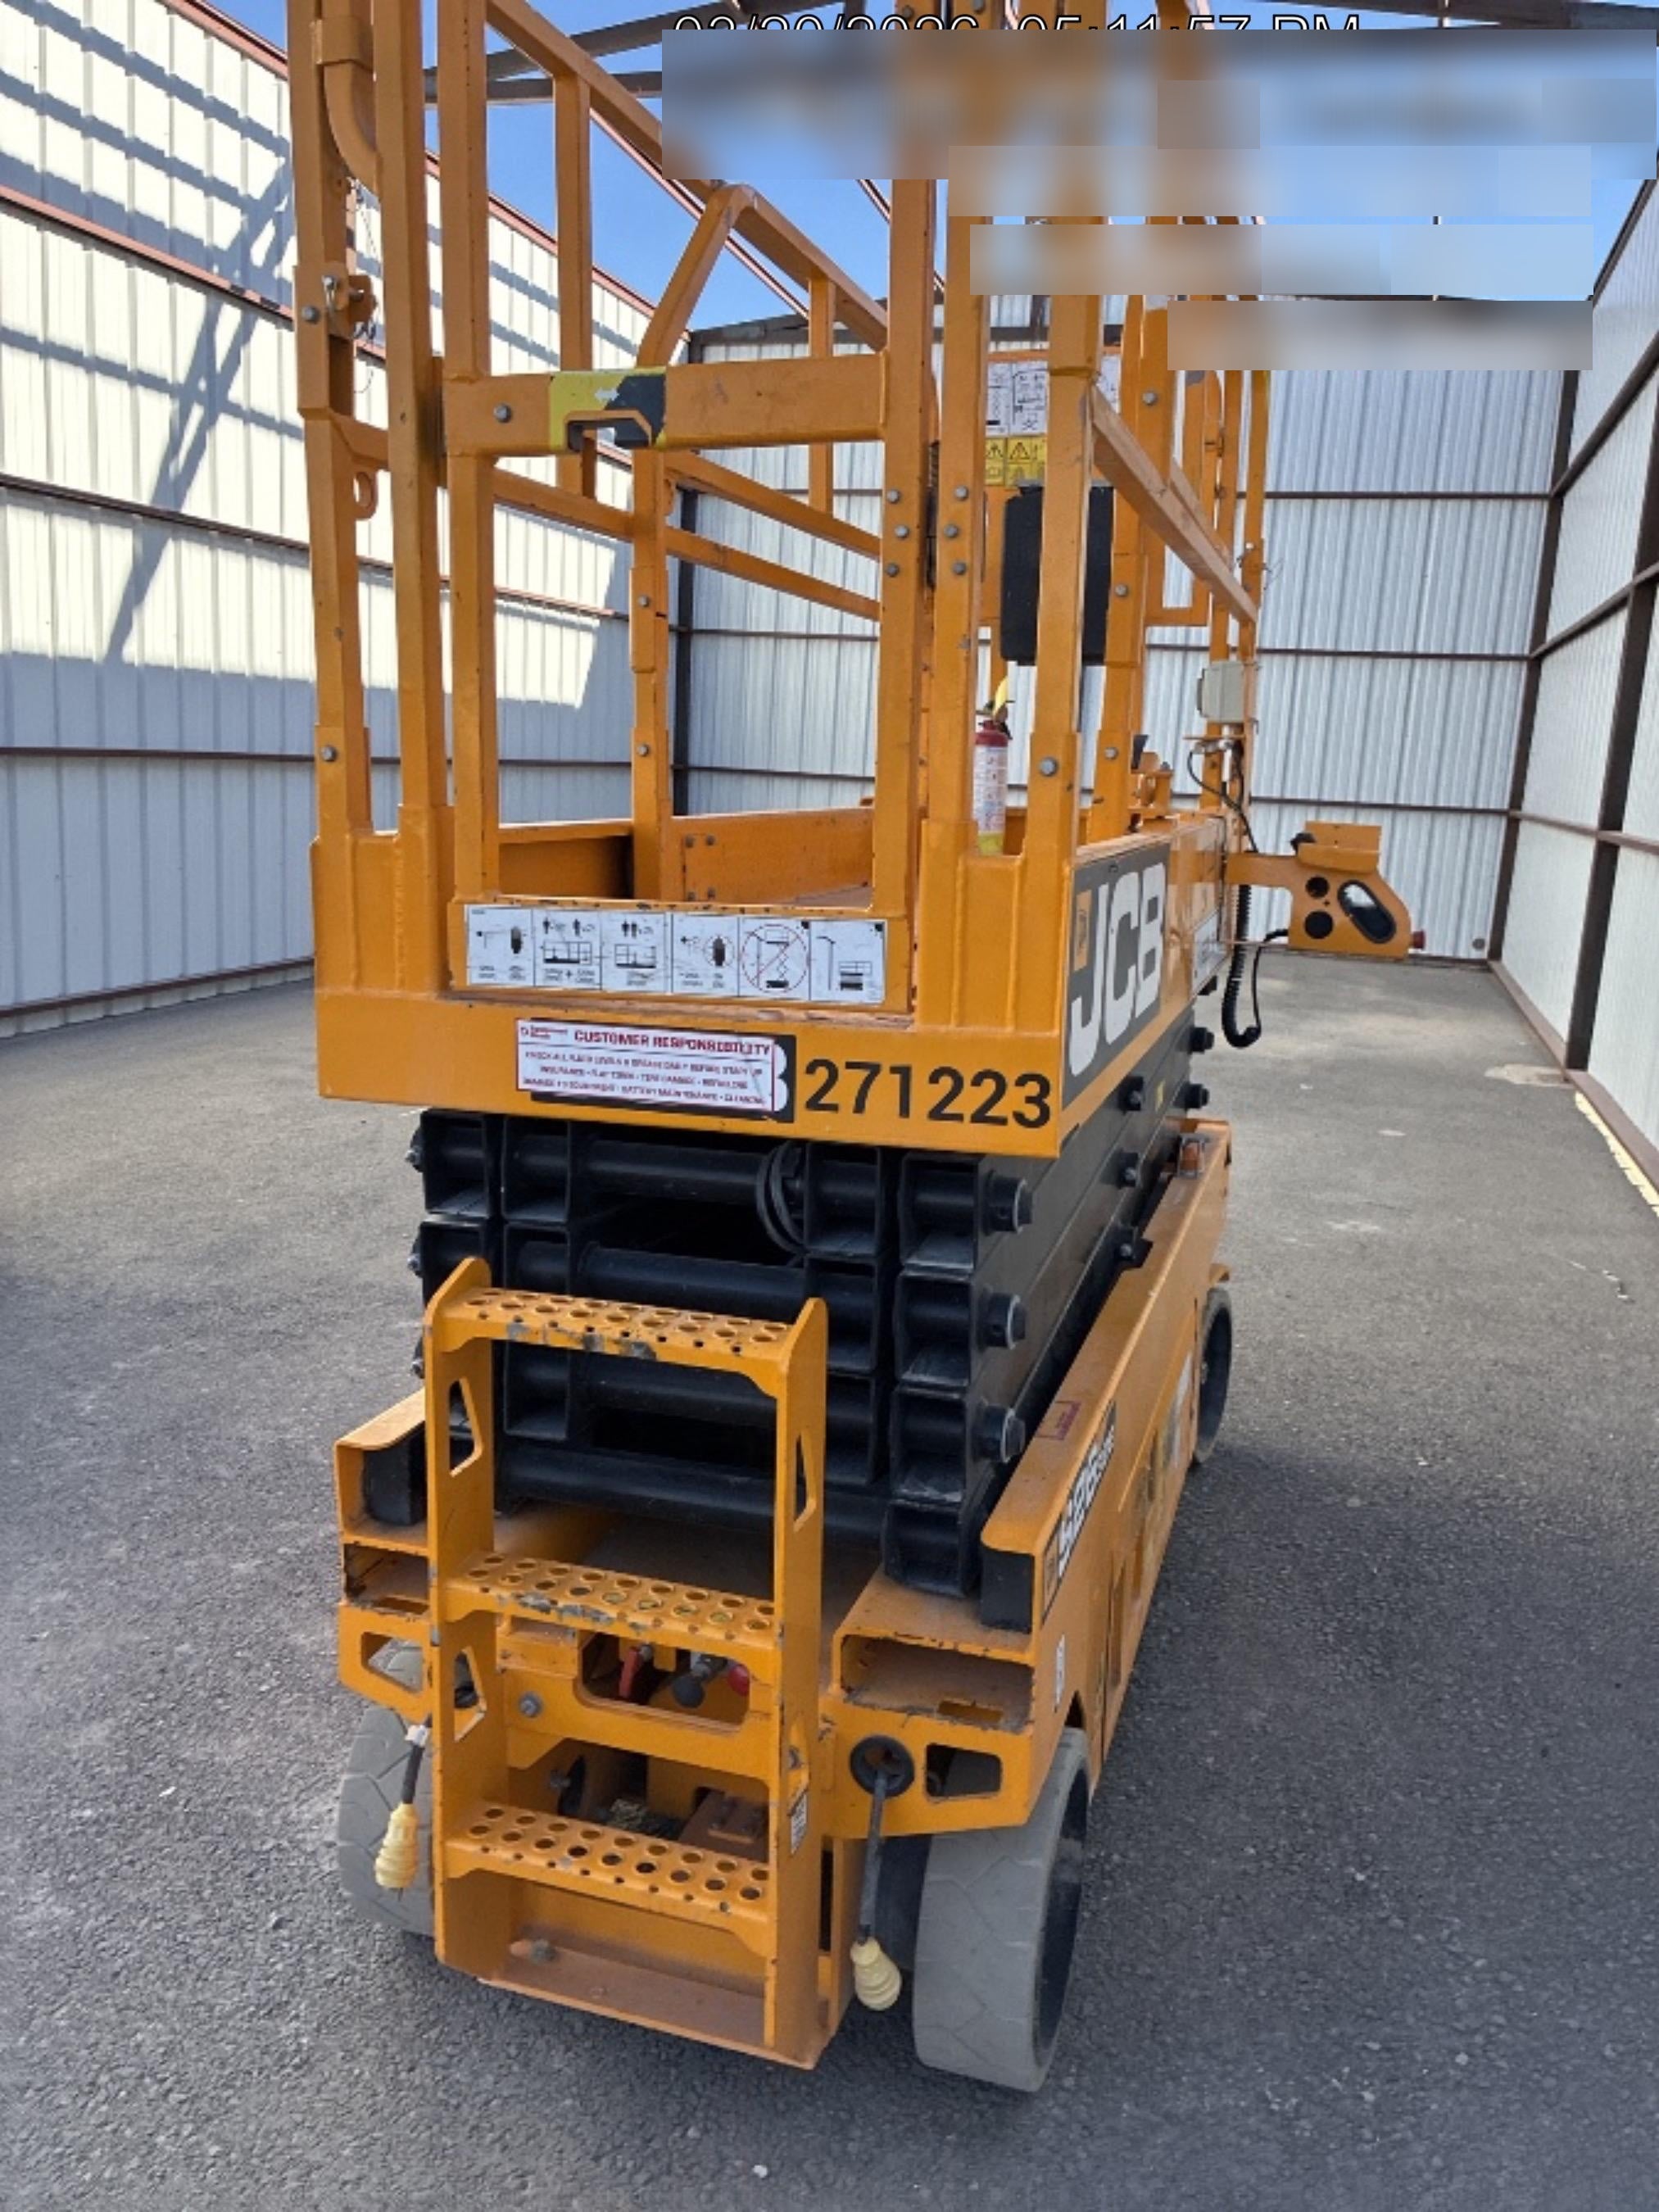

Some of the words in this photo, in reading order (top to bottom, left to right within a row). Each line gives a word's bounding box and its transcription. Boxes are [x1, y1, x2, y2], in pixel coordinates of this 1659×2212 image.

[1069, 862, 1166, 1077] JCB
[574, 1029, 649, 1047] CUSTOMER
[805, 1058, 1051, 1128] 271223
